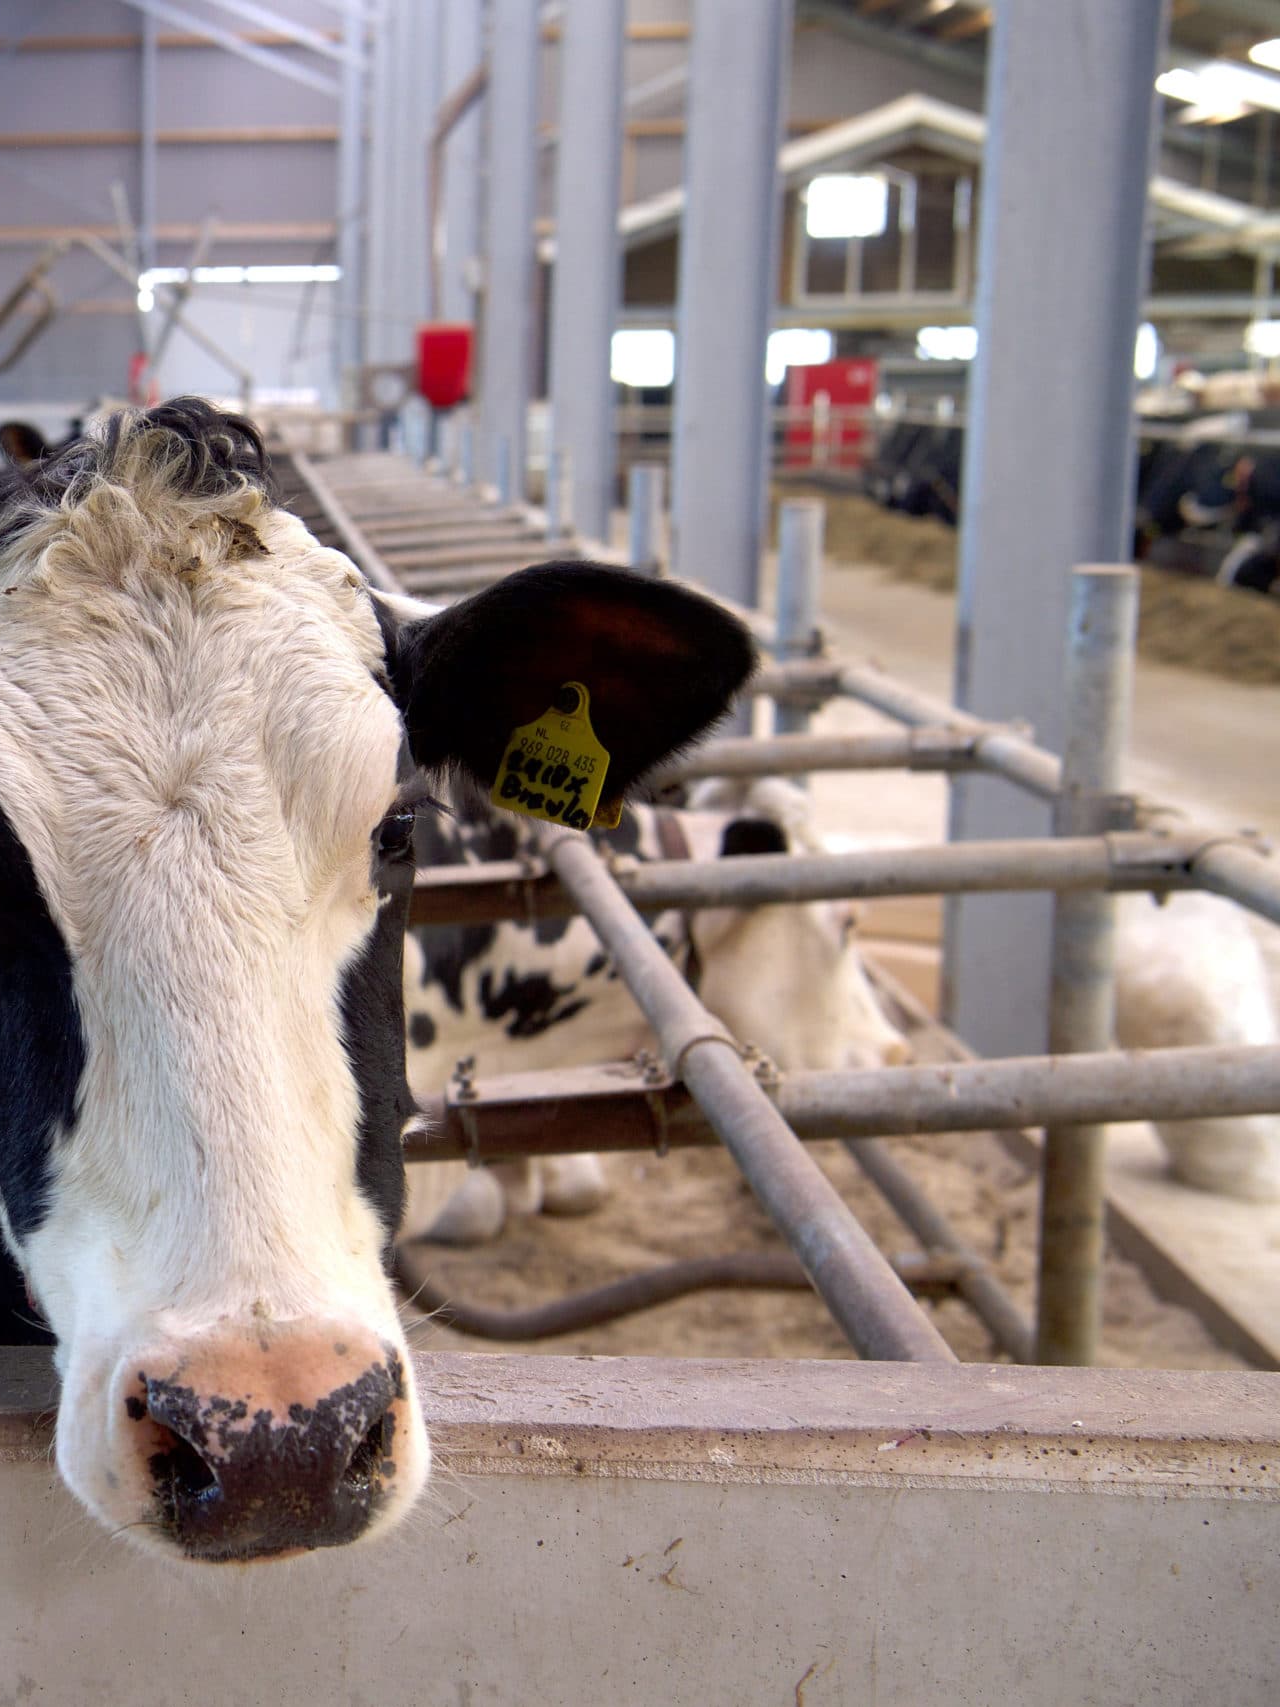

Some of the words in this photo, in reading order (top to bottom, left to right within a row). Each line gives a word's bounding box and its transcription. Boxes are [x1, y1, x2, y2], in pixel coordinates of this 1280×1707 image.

[535, 727, 549, 740] NL
[520, 737, 543, 756] 969
[546, 745, 570, 765] 028
[574, 755, 596, 774] 435
